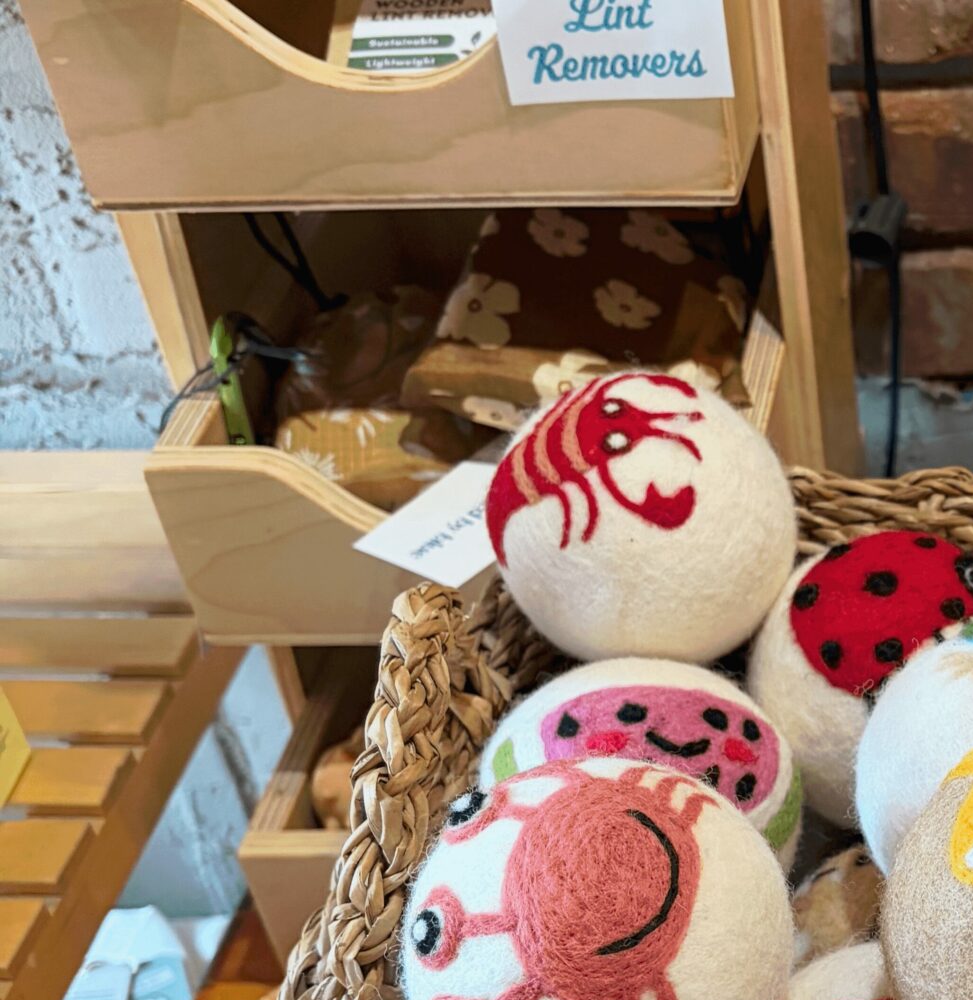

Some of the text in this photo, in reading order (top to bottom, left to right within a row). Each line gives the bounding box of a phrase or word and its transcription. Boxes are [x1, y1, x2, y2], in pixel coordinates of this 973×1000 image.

[371, 10, 414, 21] LINT
[564, 0, 654, 33] Lint
[368, 38, 439, 48] Sustainable
[366, 57, 436, 68] Lightweight
[527, 43, 708, 84] Removers
